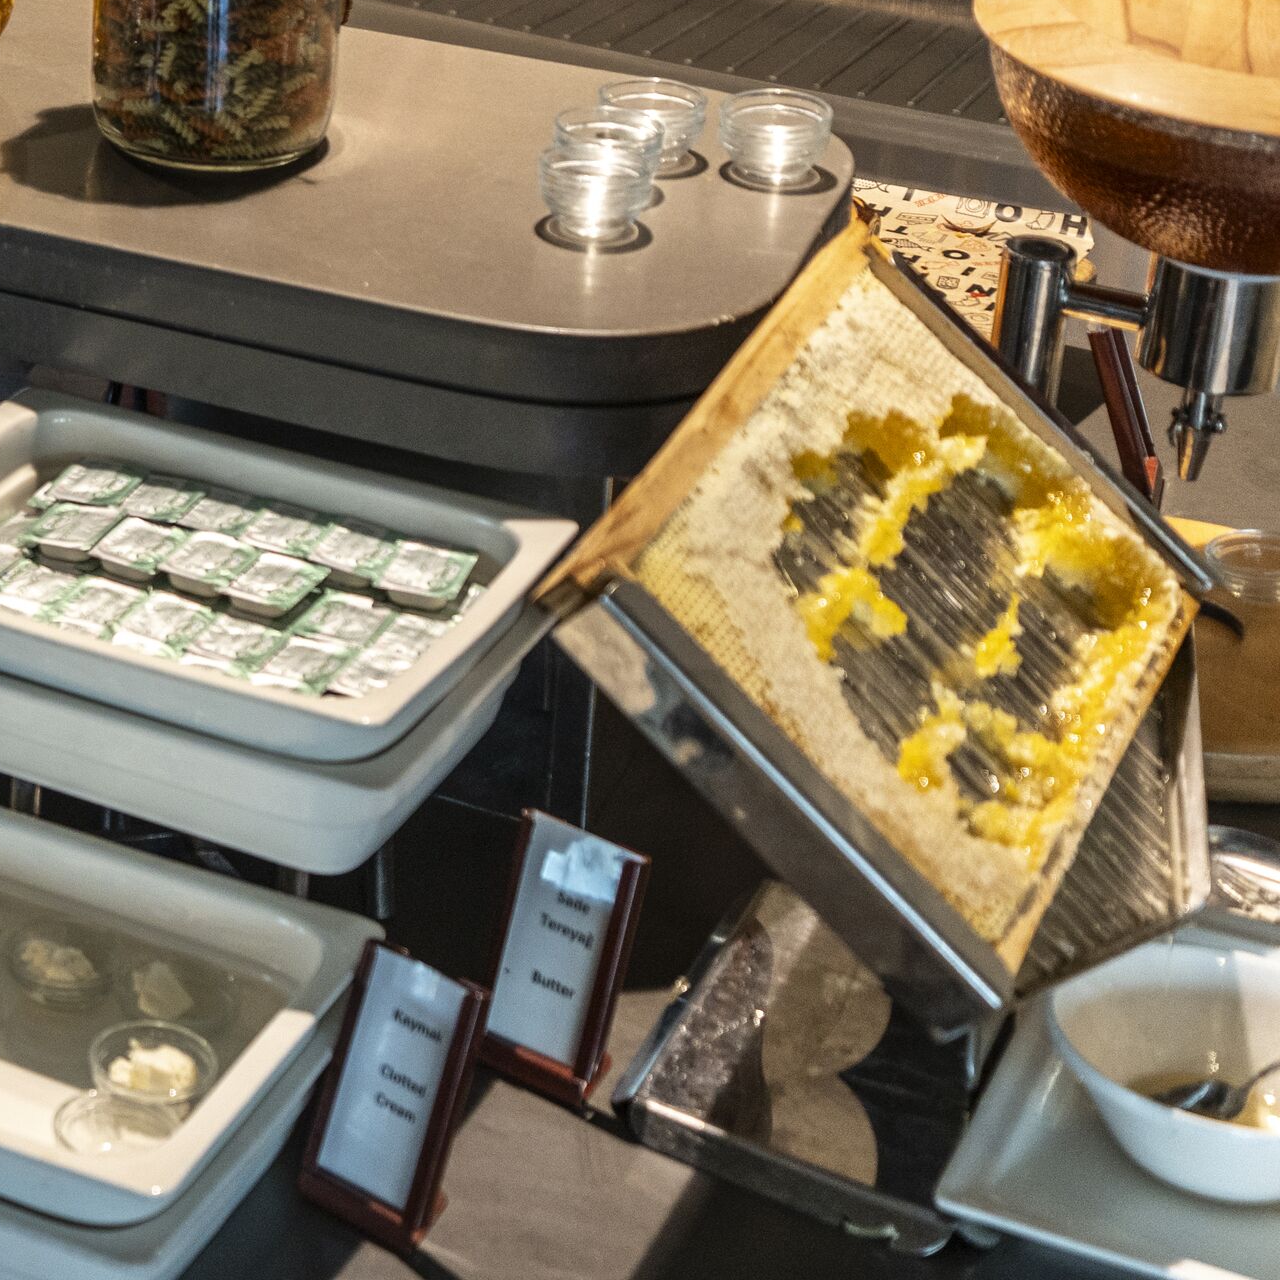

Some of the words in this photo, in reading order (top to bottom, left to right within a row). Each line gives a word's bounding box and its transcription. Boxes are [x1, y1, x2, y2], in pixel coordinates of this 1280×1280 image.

[556, 889, 590, 914] Sade
[531, 969, 575, 1001] Butter
[379, 1062, 428, 1098] Clotted
[373, 1090, 417, 1124] Cream
